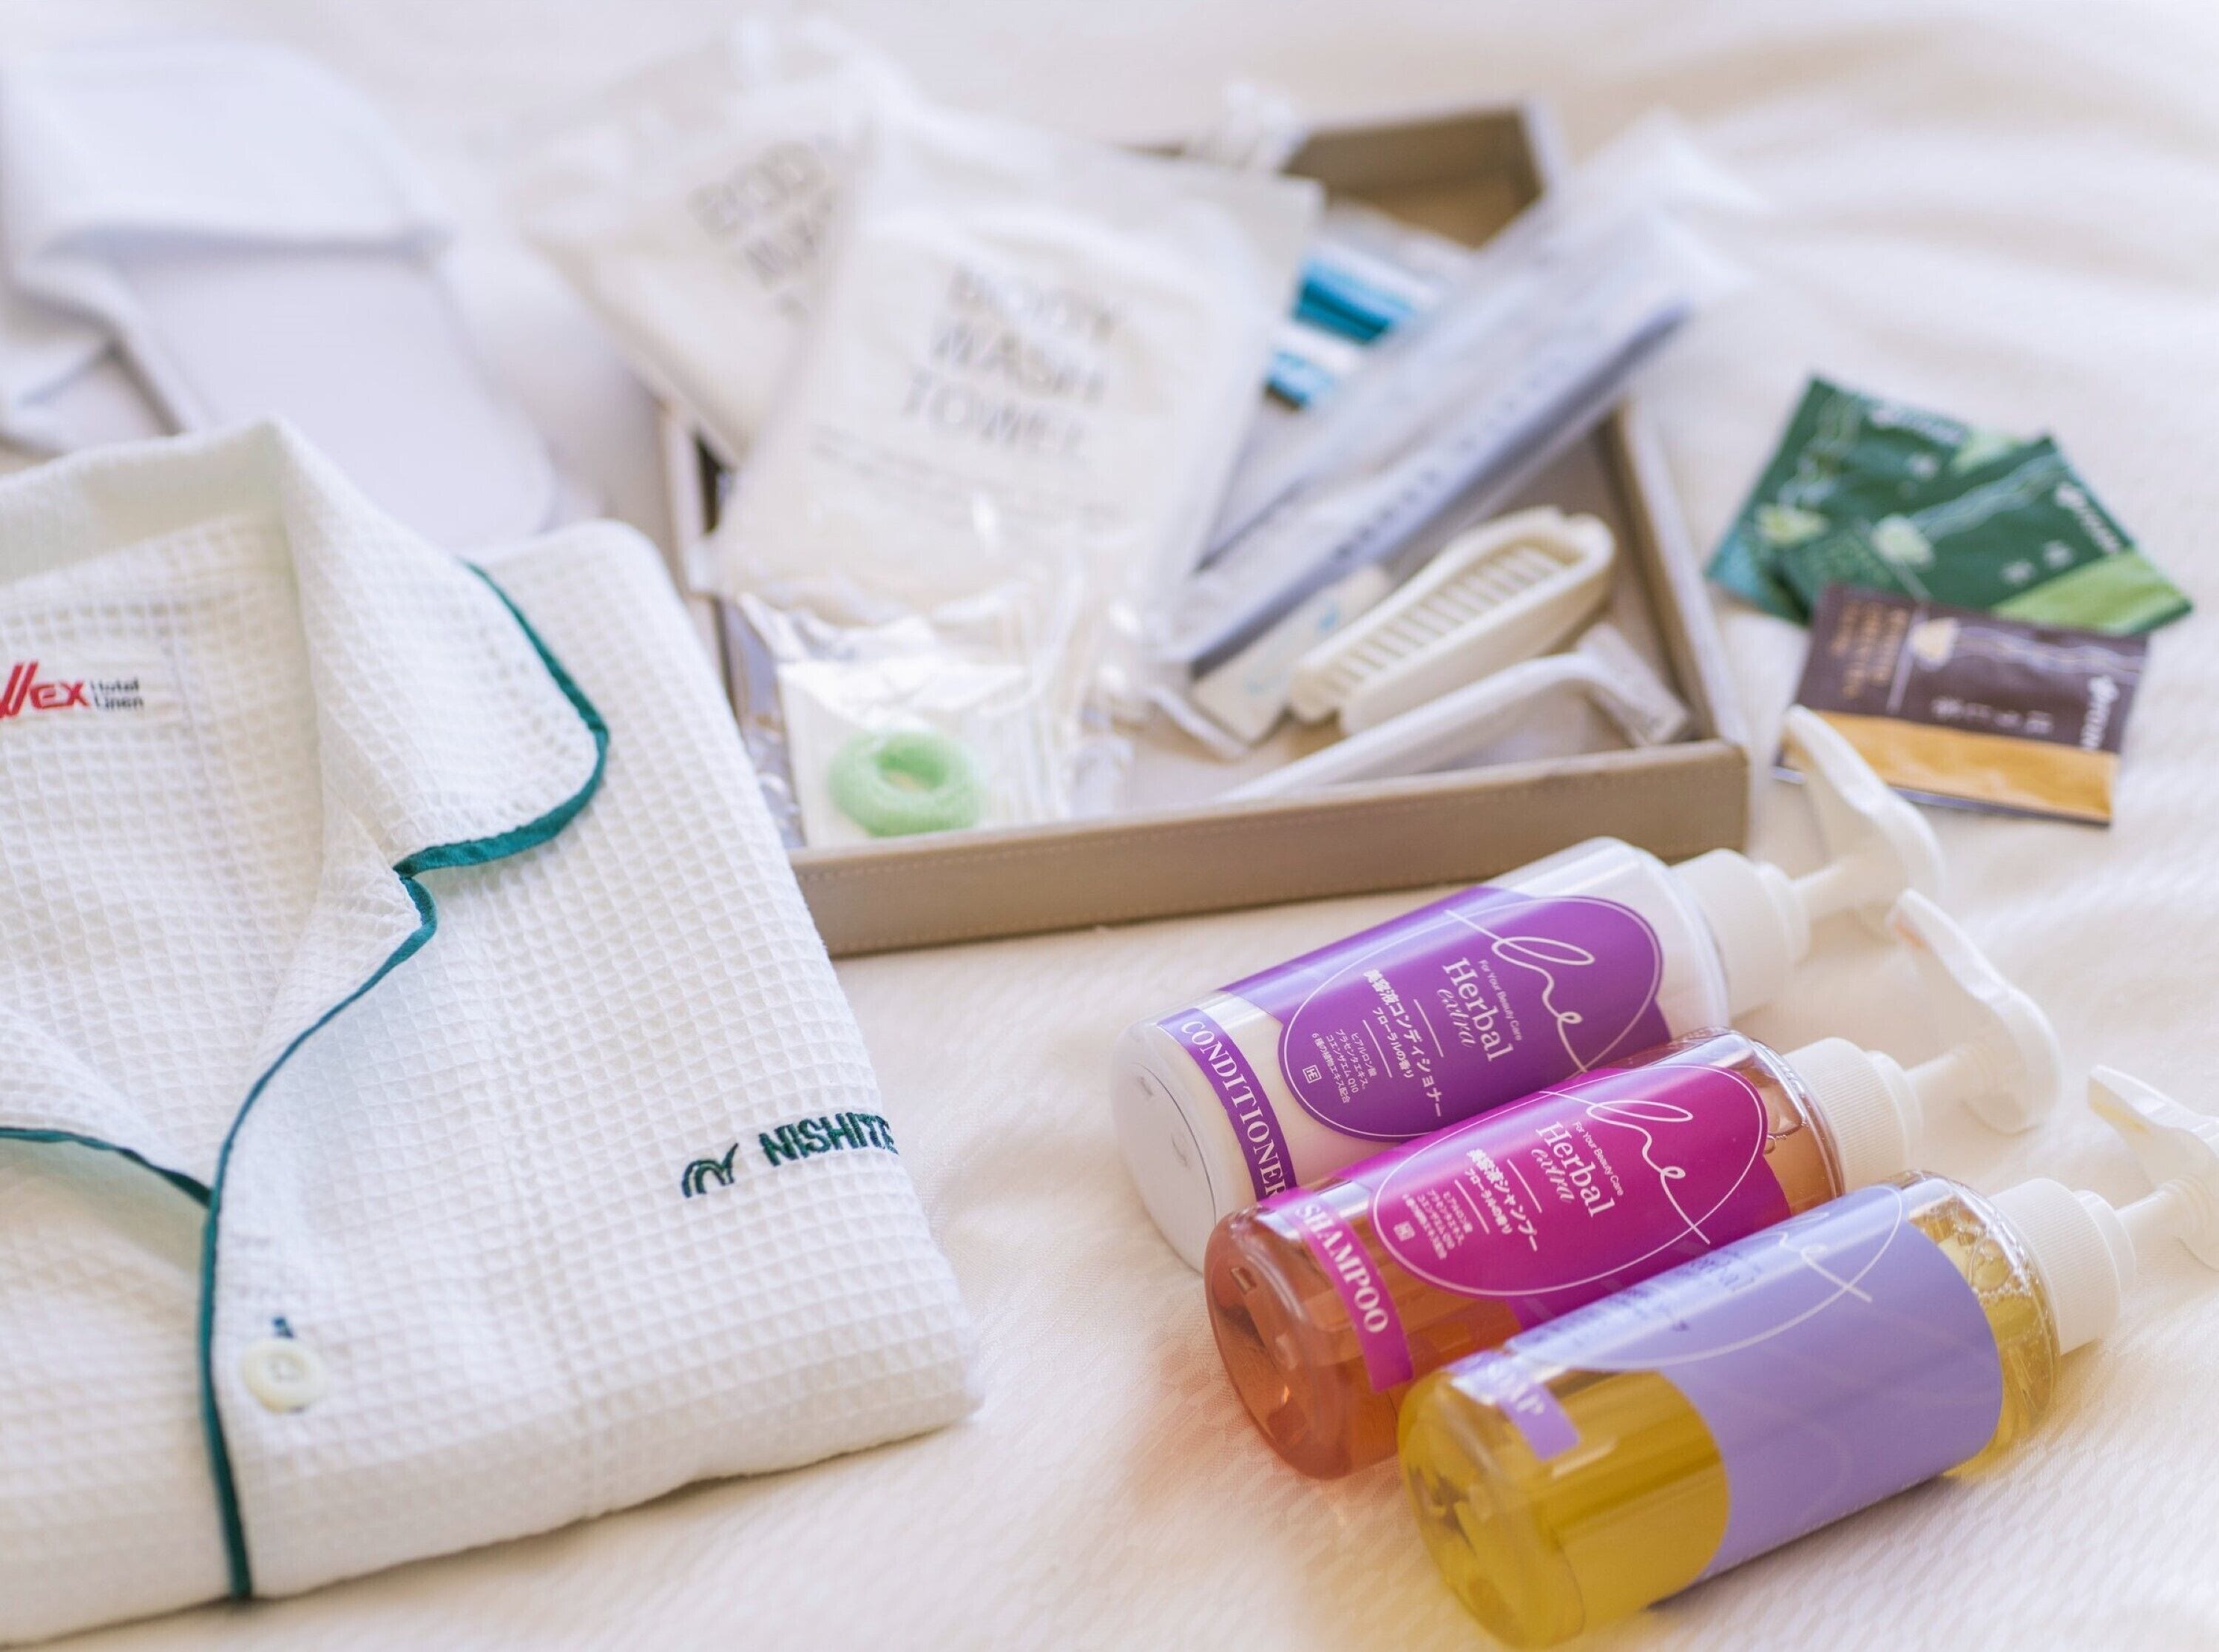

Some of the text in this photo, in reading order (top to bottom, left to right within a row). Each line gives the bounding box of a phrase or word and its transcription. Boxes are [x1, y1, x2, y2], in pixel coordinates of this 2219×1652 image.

[1436, 988, 1476, 1048] extra
[1442, 958, 1513, 1062] Herbal
[1487, 972, 1502, 991] Your
[1496, 990, 1515, 1019] Beauty
[1510, 1020, 1522, 1041] Care
[1531, 1148, 1575, 1204] extra
[1536, 1121, 1615, 1218] Herbal
[1583, 1131, 1597, 1149] Your
[1593, 1147, 1613, 1175] Beauty
[1610, 1174, 1624, 1196] Care
[1294, 1204, 1389, 1333] SHAMPOO
